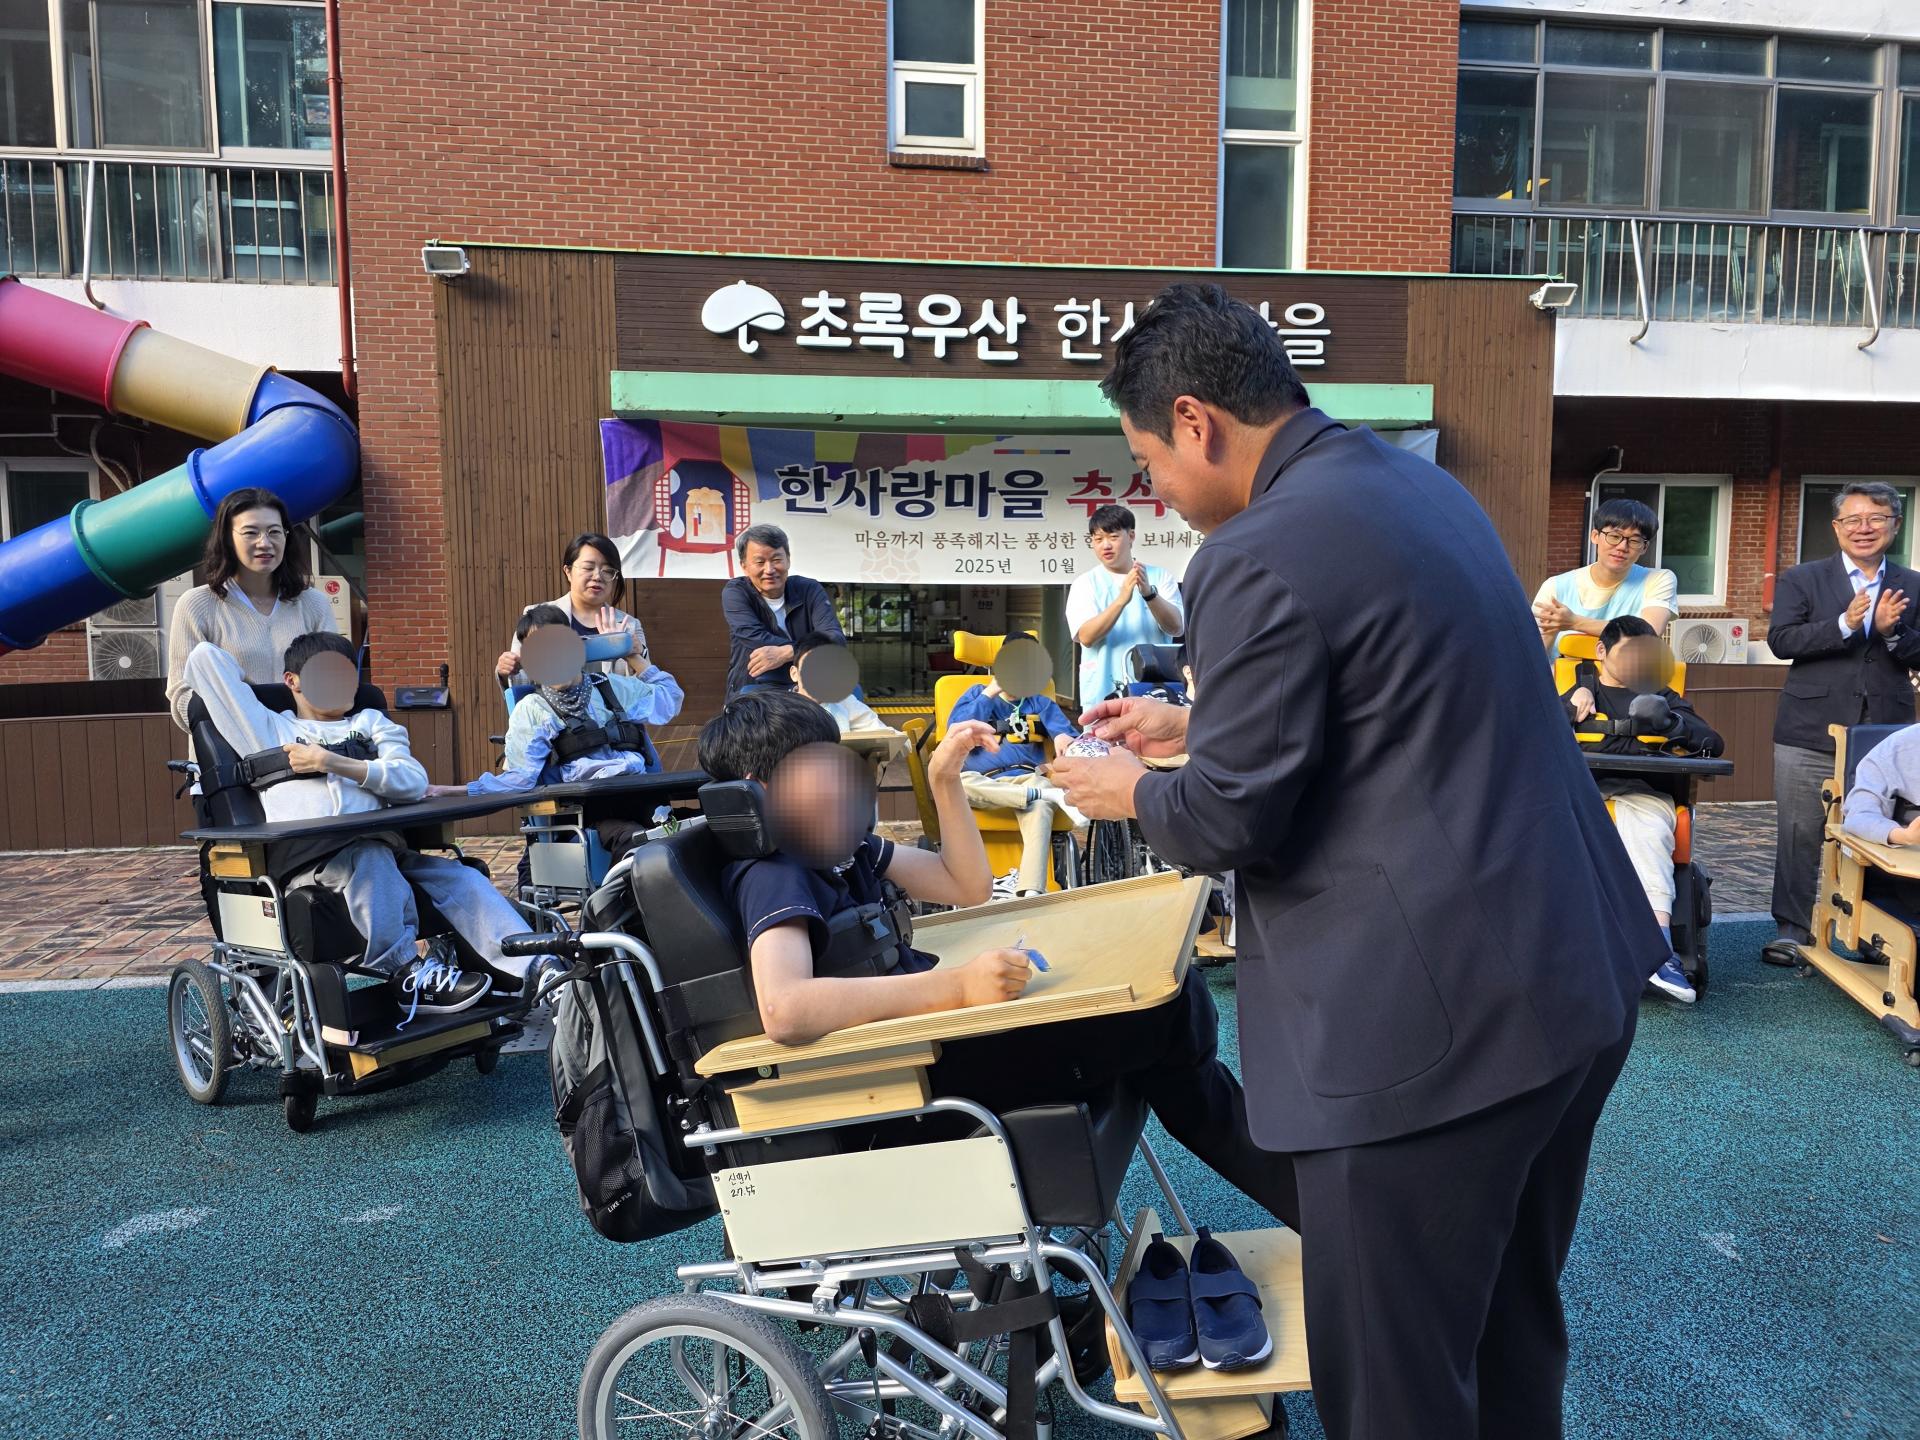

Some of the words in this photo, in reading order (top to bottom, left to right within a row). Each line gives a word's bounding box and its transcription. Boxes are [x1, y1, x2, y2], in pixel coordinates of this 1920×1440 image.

[796, 290, 1026, 361] 초록우산
[775, 464, 1049, 519] 한사랑마을
[1066, 469, 1166, 518] 추석
[855, 530, 924, 550] 마음까지
[931, 531, 1018, 550] 풍족해지는
[1024, 531, 1077, 550] 풍성한
[954, 558, 1012, 574] 2025년
[1039, 557, 1075, 574] 10월
